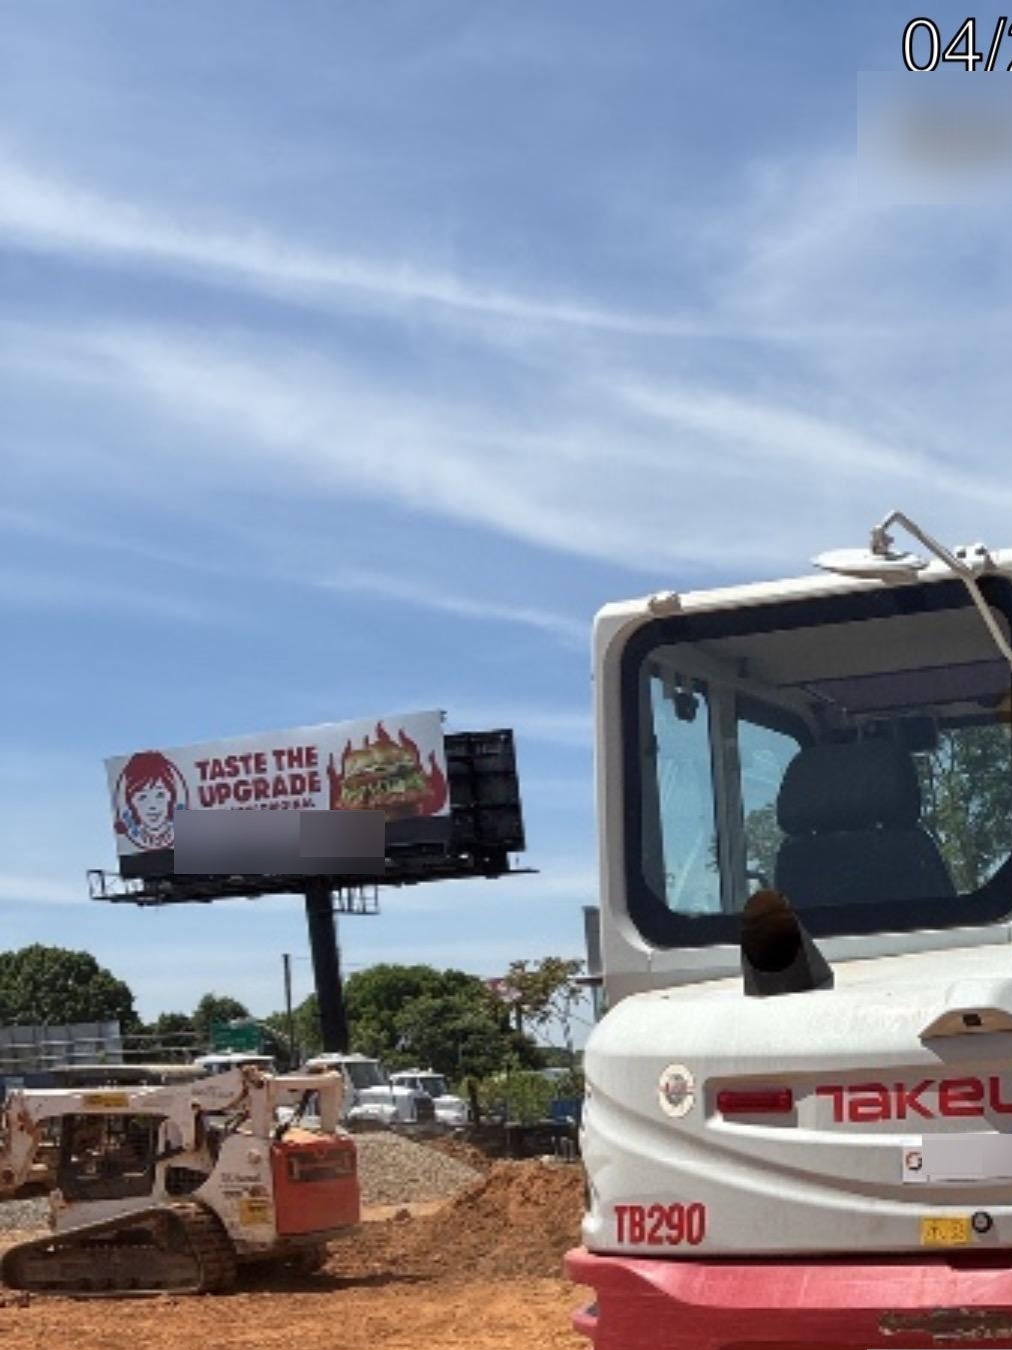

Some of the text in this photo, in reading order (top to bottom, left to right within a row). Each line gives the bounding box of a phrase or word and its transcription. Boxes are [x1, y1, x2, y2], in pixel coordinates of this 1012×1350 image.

[195, 746, 318, 780] TASTE THE
[198, 771, 321, 807] UPGRADE
[614, 1202, 706, 1246] TB290
